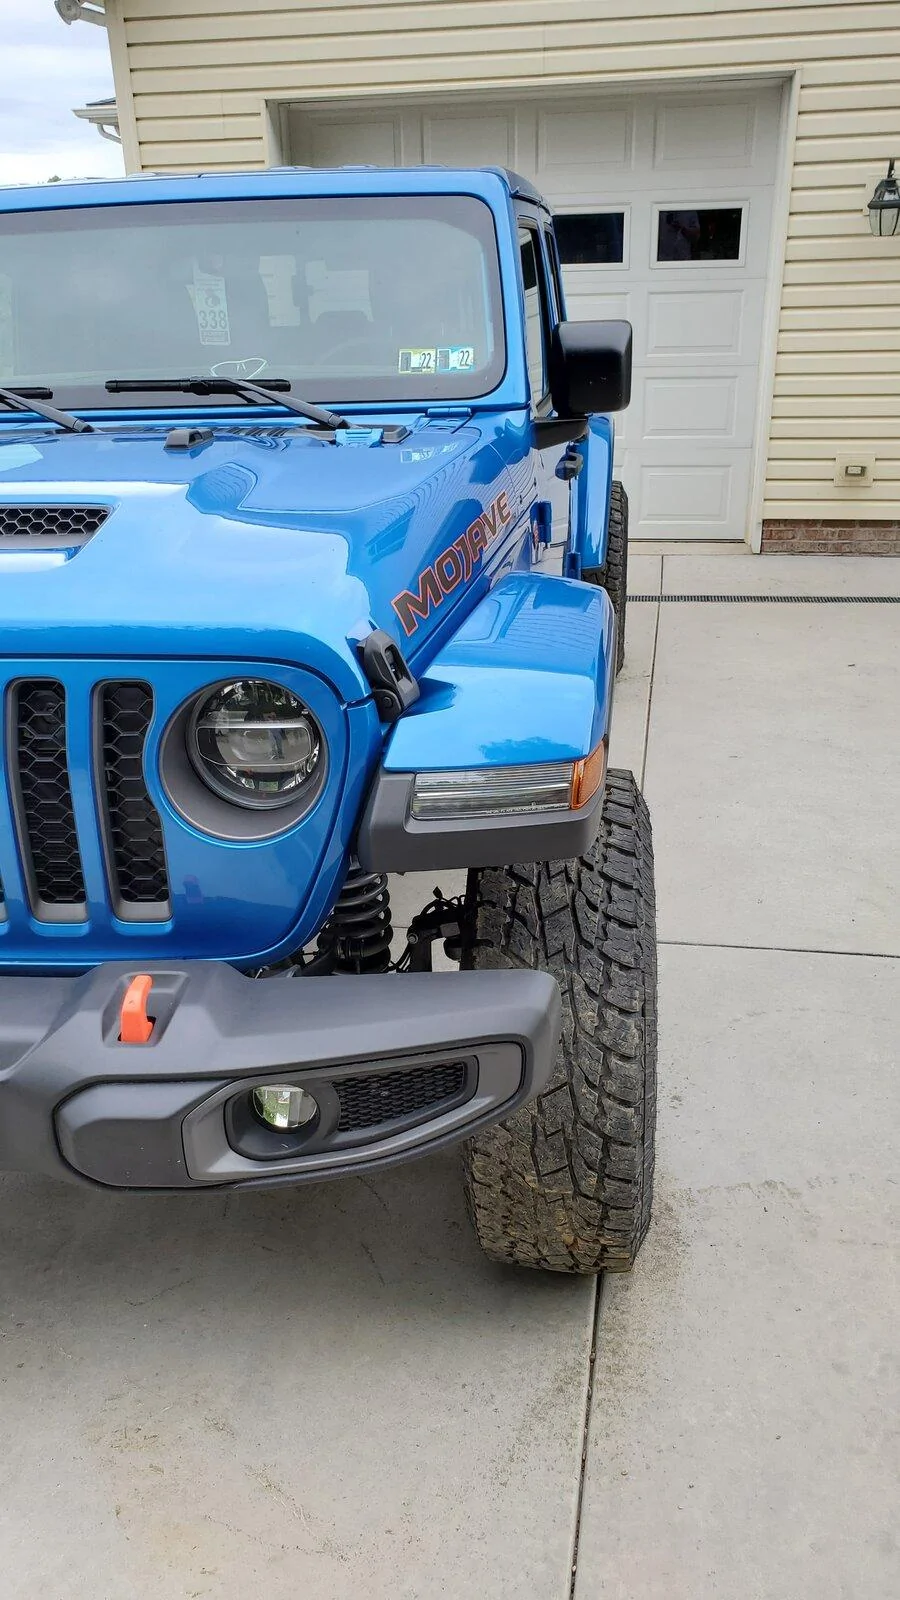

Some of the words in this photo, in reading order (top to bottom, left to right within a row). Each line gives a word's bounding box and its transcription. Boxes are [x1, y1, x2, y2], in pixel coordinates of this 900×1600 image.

[199, 310, 228, 330] 338
[421, 352, 432, 369] 22
[459, 350, 470, 367] 22
[390, 490, 512, 637] MOJAVE
